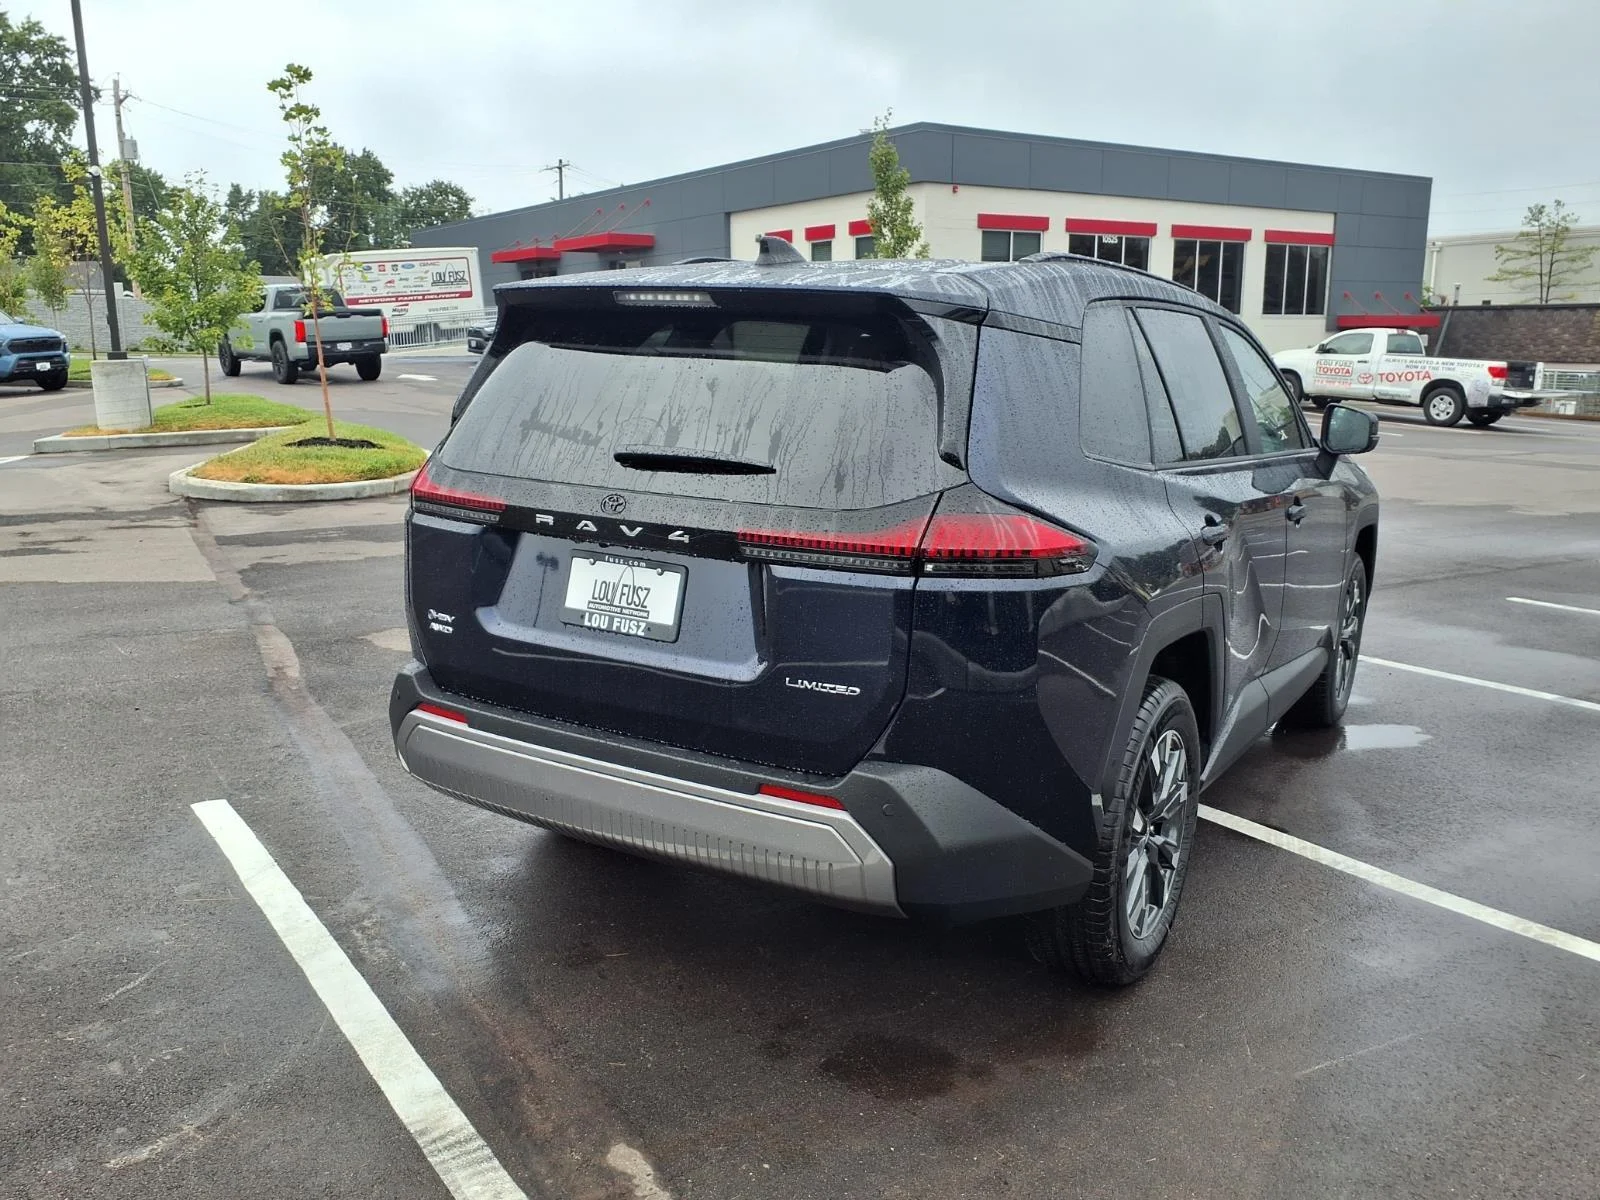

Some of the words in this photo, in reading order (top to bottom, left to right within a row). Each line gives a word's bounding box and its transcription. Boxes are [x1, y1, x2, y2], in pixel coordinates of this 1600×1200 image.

[432, 271, 446, 281] LOU
[448, 270, 466, 281] FUSZ
[1318, 366, 1351, 375] TOYOTA
[1378, 370, 1432, 383] TOYOTA
[535, 513, 690, 544] RAV4
[605, 555, 647, 567] fusz.com
[591, 579, 616, 603] LOU
[618, 583, 651, 609] FUSZ
[588, 602, 622, 613] AUTOMOTIVE
[621, 608, 649, 618] NETWORK
[429, 622, 454, 634] AWD
[583, 612, 609, 629] LOU
[612, 617, 647, 636] FUSZ
[785, 677, 861, 696] LIMITED
